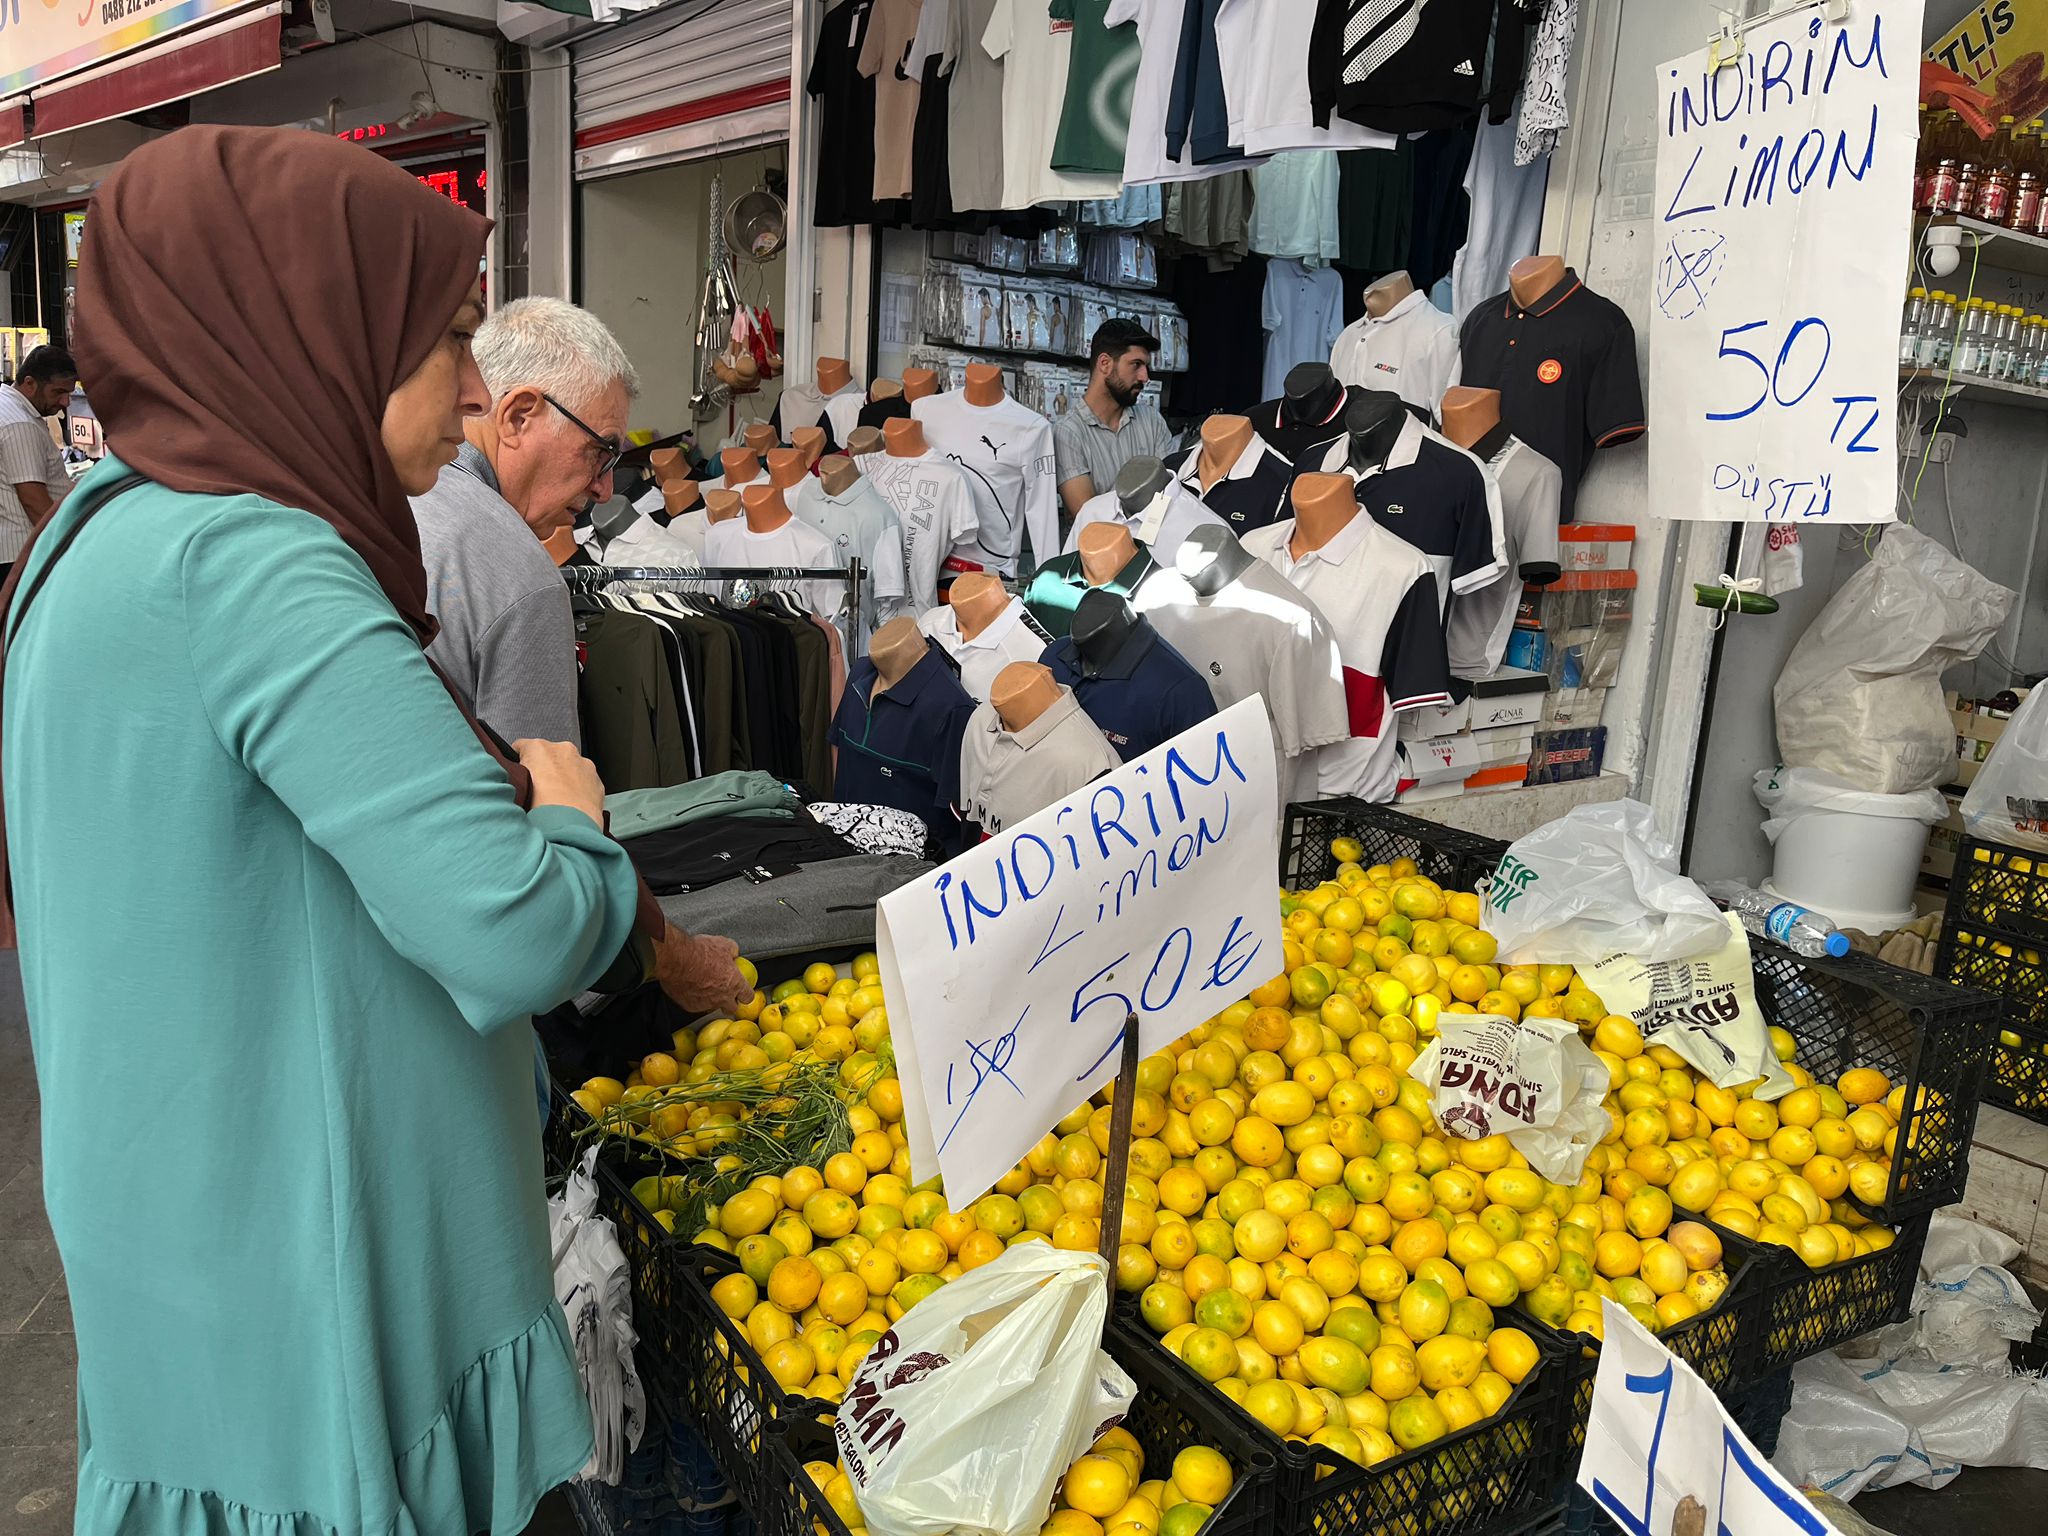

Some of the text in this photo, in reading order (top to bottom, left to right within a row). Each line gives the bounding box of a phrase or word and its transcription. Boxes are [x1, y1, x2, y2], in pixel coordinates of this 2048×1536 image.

[102, 2, 124, 25] 0488
[1453, 67, 1475, 76] adidas
[1705, 316, 1832, 421] 50
[74, 424, 86, 437] 50
[1830, 396, 1880, 453] TL
[909, 479, 939, 532] EA7
[1696, 989, 1704, 998] &
[1440, 1046, 1469, 1059] SALO
